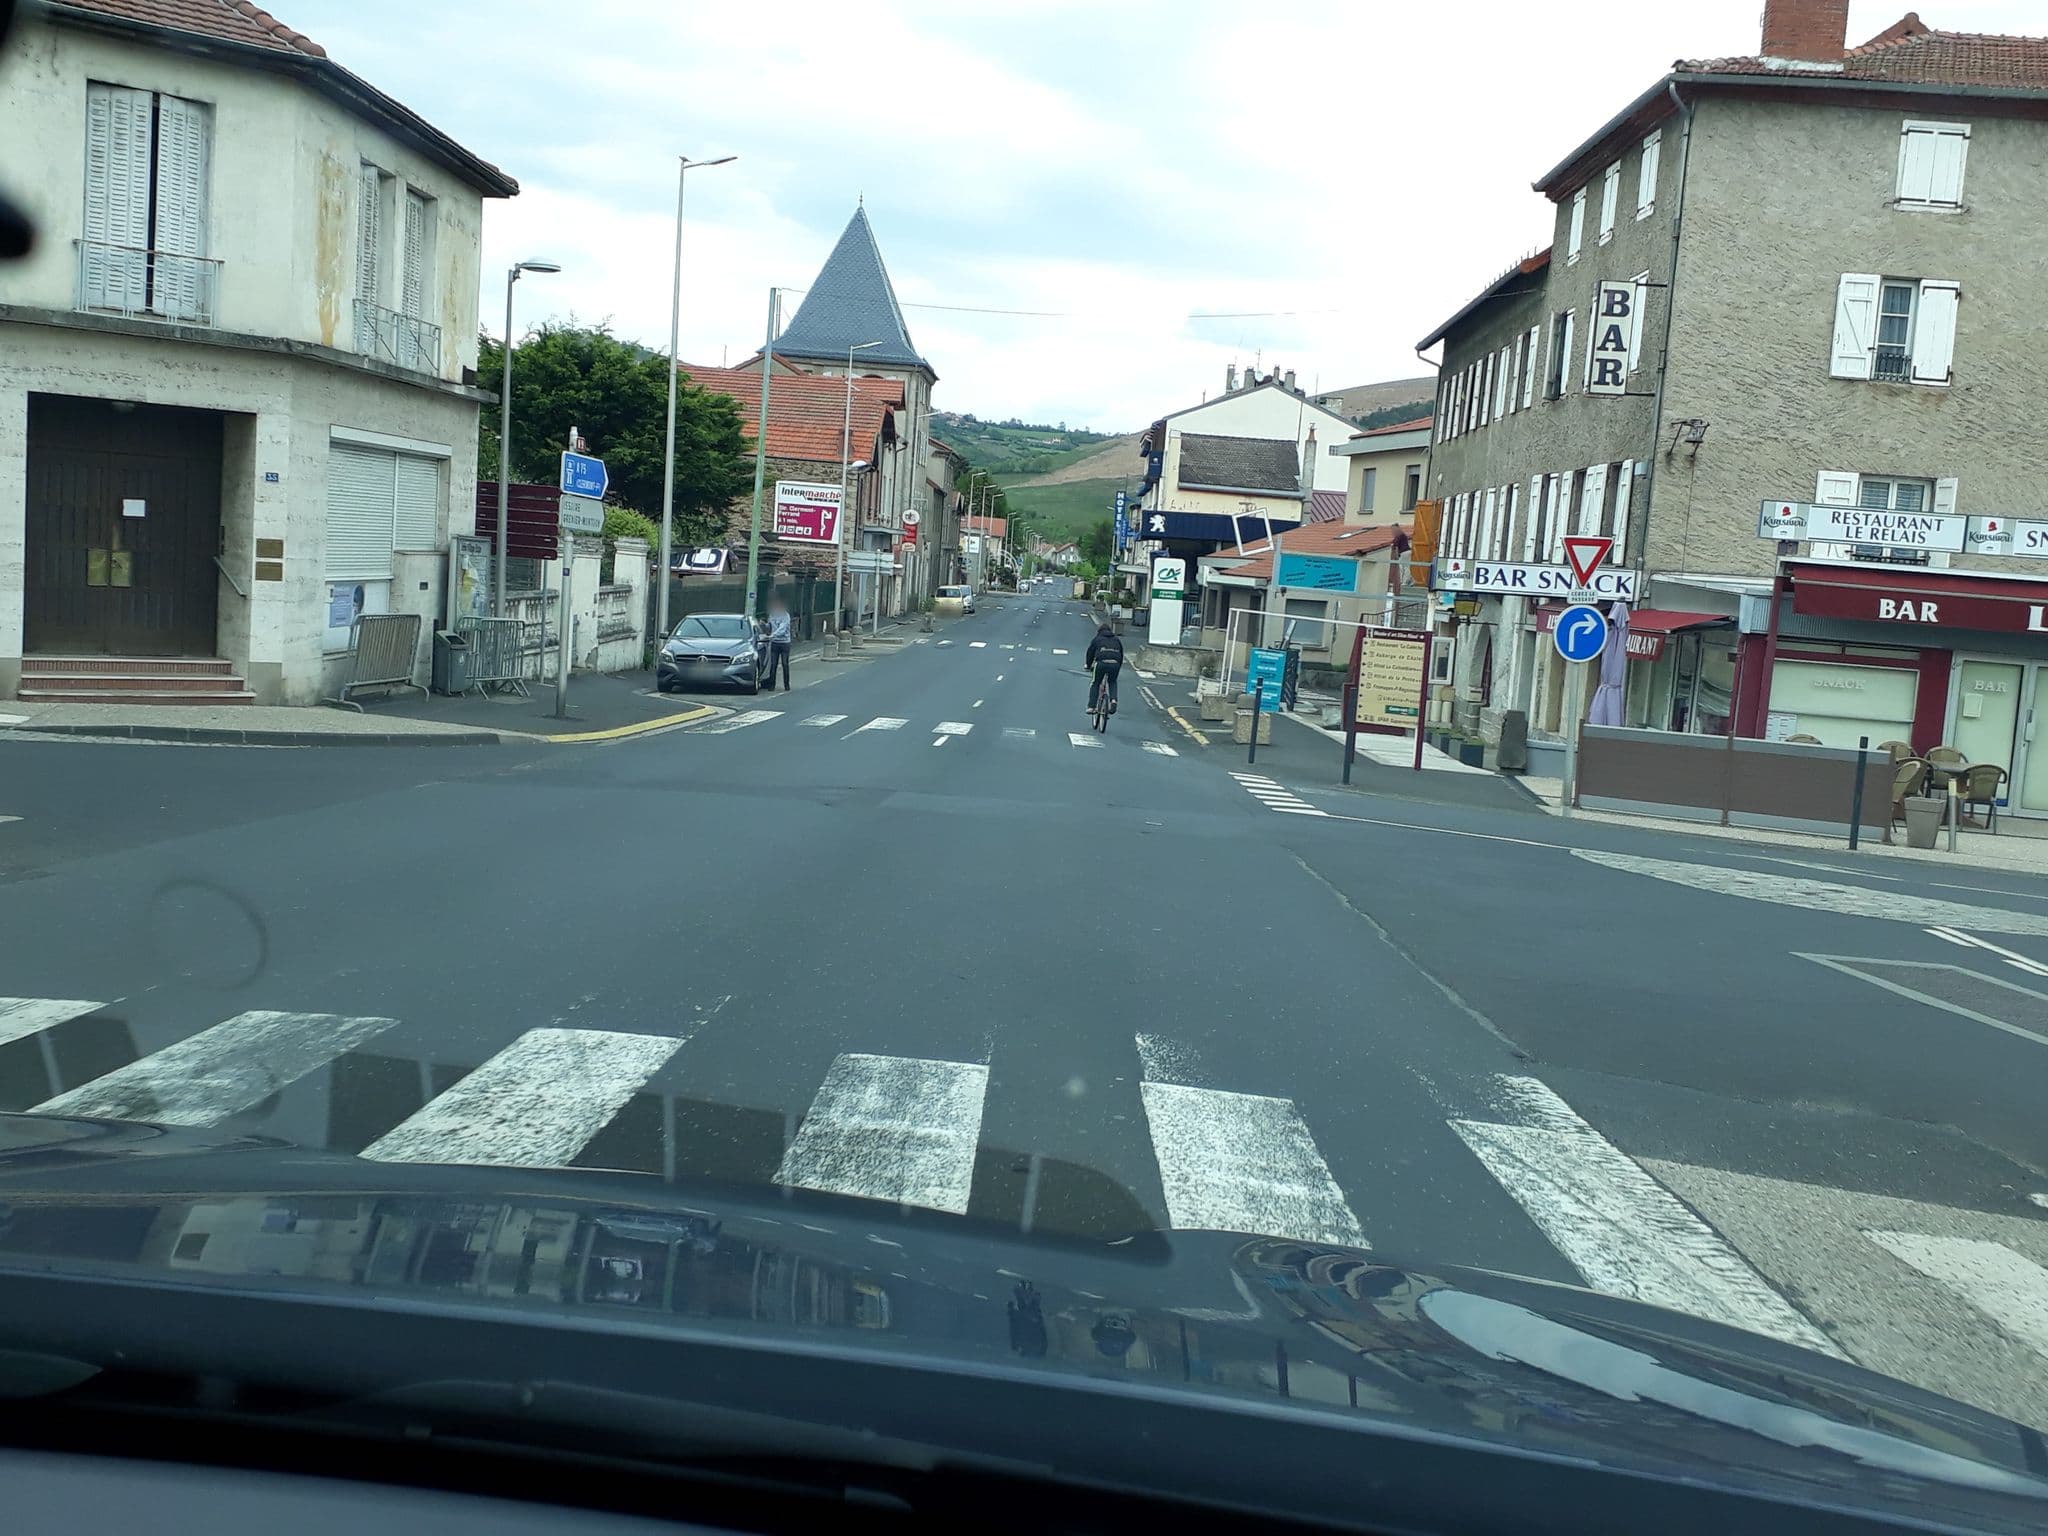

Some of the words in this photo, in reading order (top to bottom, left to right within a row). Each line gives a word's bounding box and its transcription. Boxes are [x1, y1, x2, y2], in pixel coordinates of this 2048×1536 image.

[1593, 289, 1630, 386] BAR
[1115, 491, 1125, 528] HOTEL
[1831, 511, 1945, 531] RESTAURANT
[1846, 526, 1865, 539] LE
[1870, 527, 1926, 544] RELAIS
[1474, 567, 1527, 587] BAR
[1878, 598, 1938, 623] BAR
[1814, 676, 1865, 690] SNACK
[1974, 679, 2008, 693] BAR
